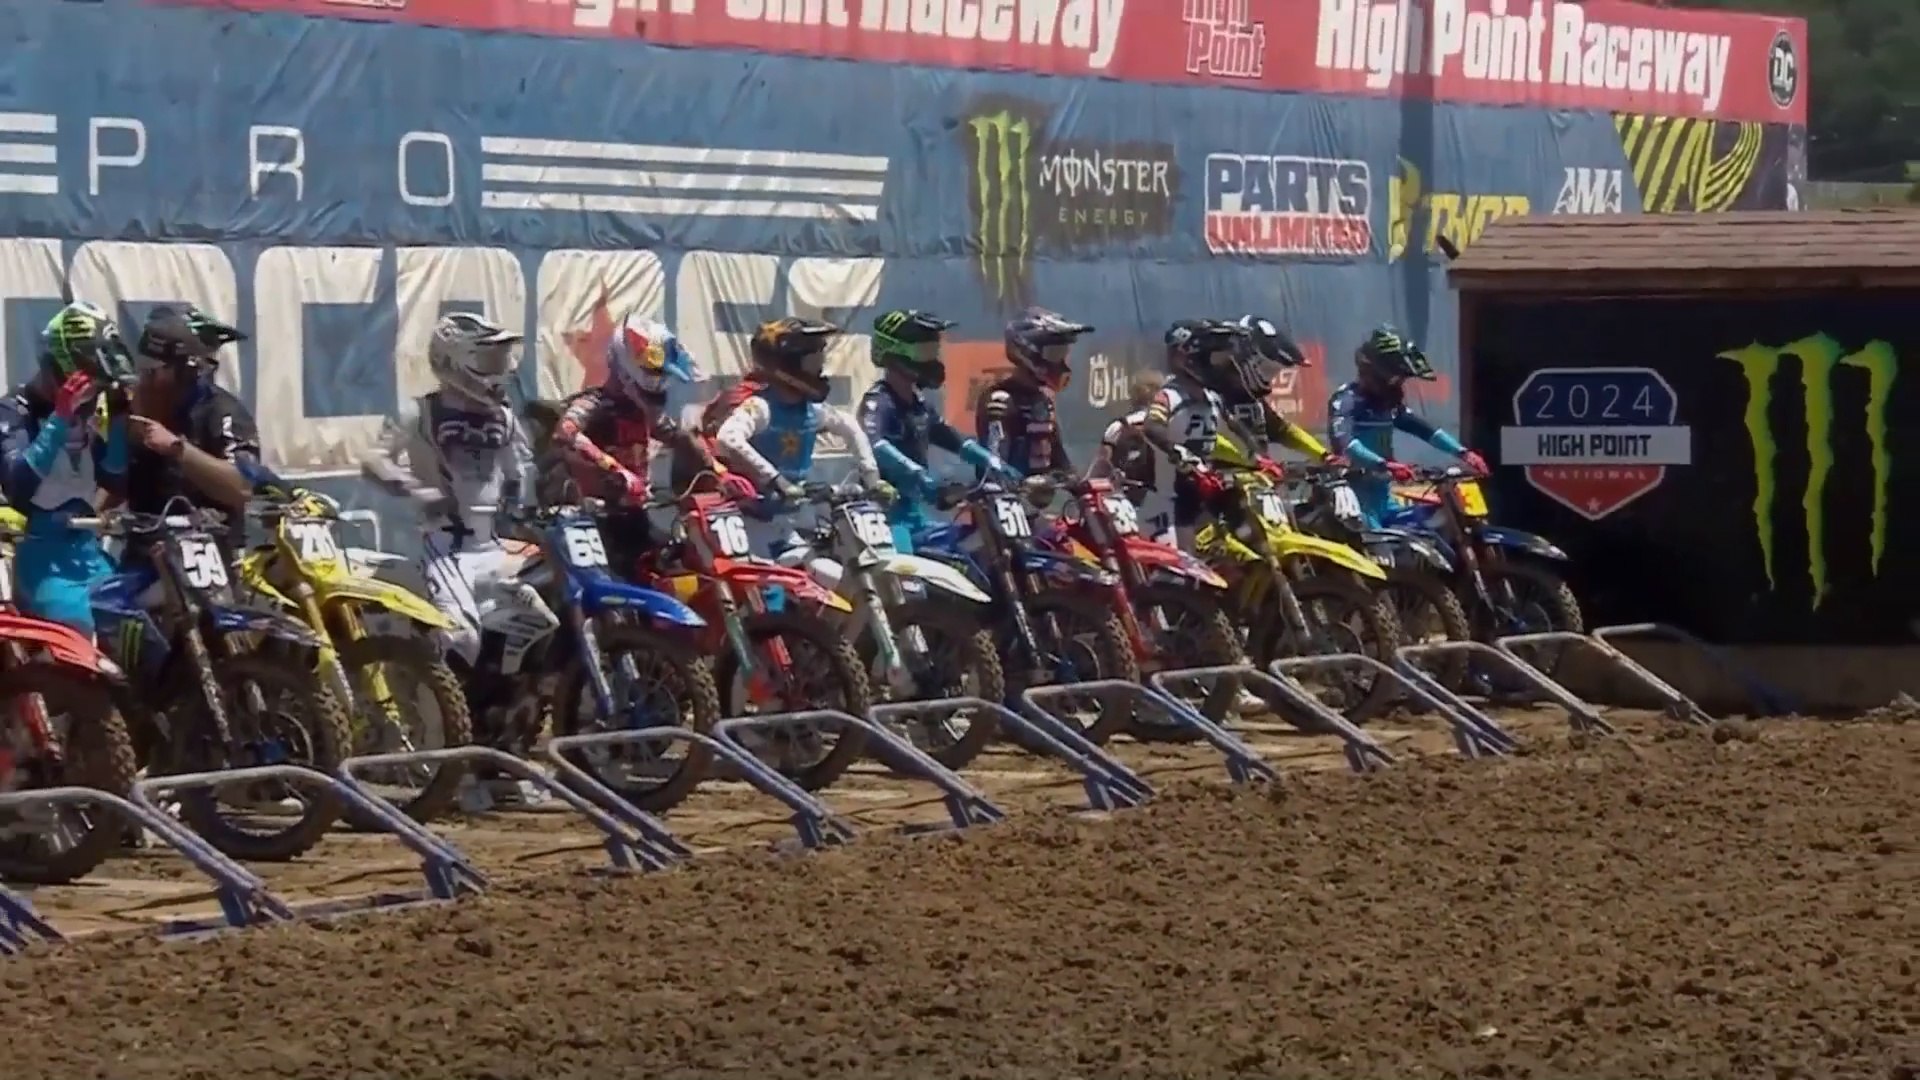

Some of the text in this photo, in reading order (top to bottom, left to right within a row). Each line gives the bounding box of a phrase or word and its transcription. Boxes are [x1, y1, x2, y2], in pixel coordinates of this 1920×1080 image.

[1186, 22, 1265, 77] Point
[1315, 0, 1732, 112] High Point Raceway
[1039, 148, 1171, 198] MONSTER
[1205, 153, 1371, 215] PARTS
[1058, 206, 1149, 226] ENERGY
[1205, 211, 1372, 254] UNLIMITED
[1536, 384, 1655, 419] 2024
[1537, 434, 1652, 457] HIGH POINT
[1543, 470, 1648, 480] NATIONAL
[564, 526, 608, 567] 69
[711, 515, 749, 556] 16
